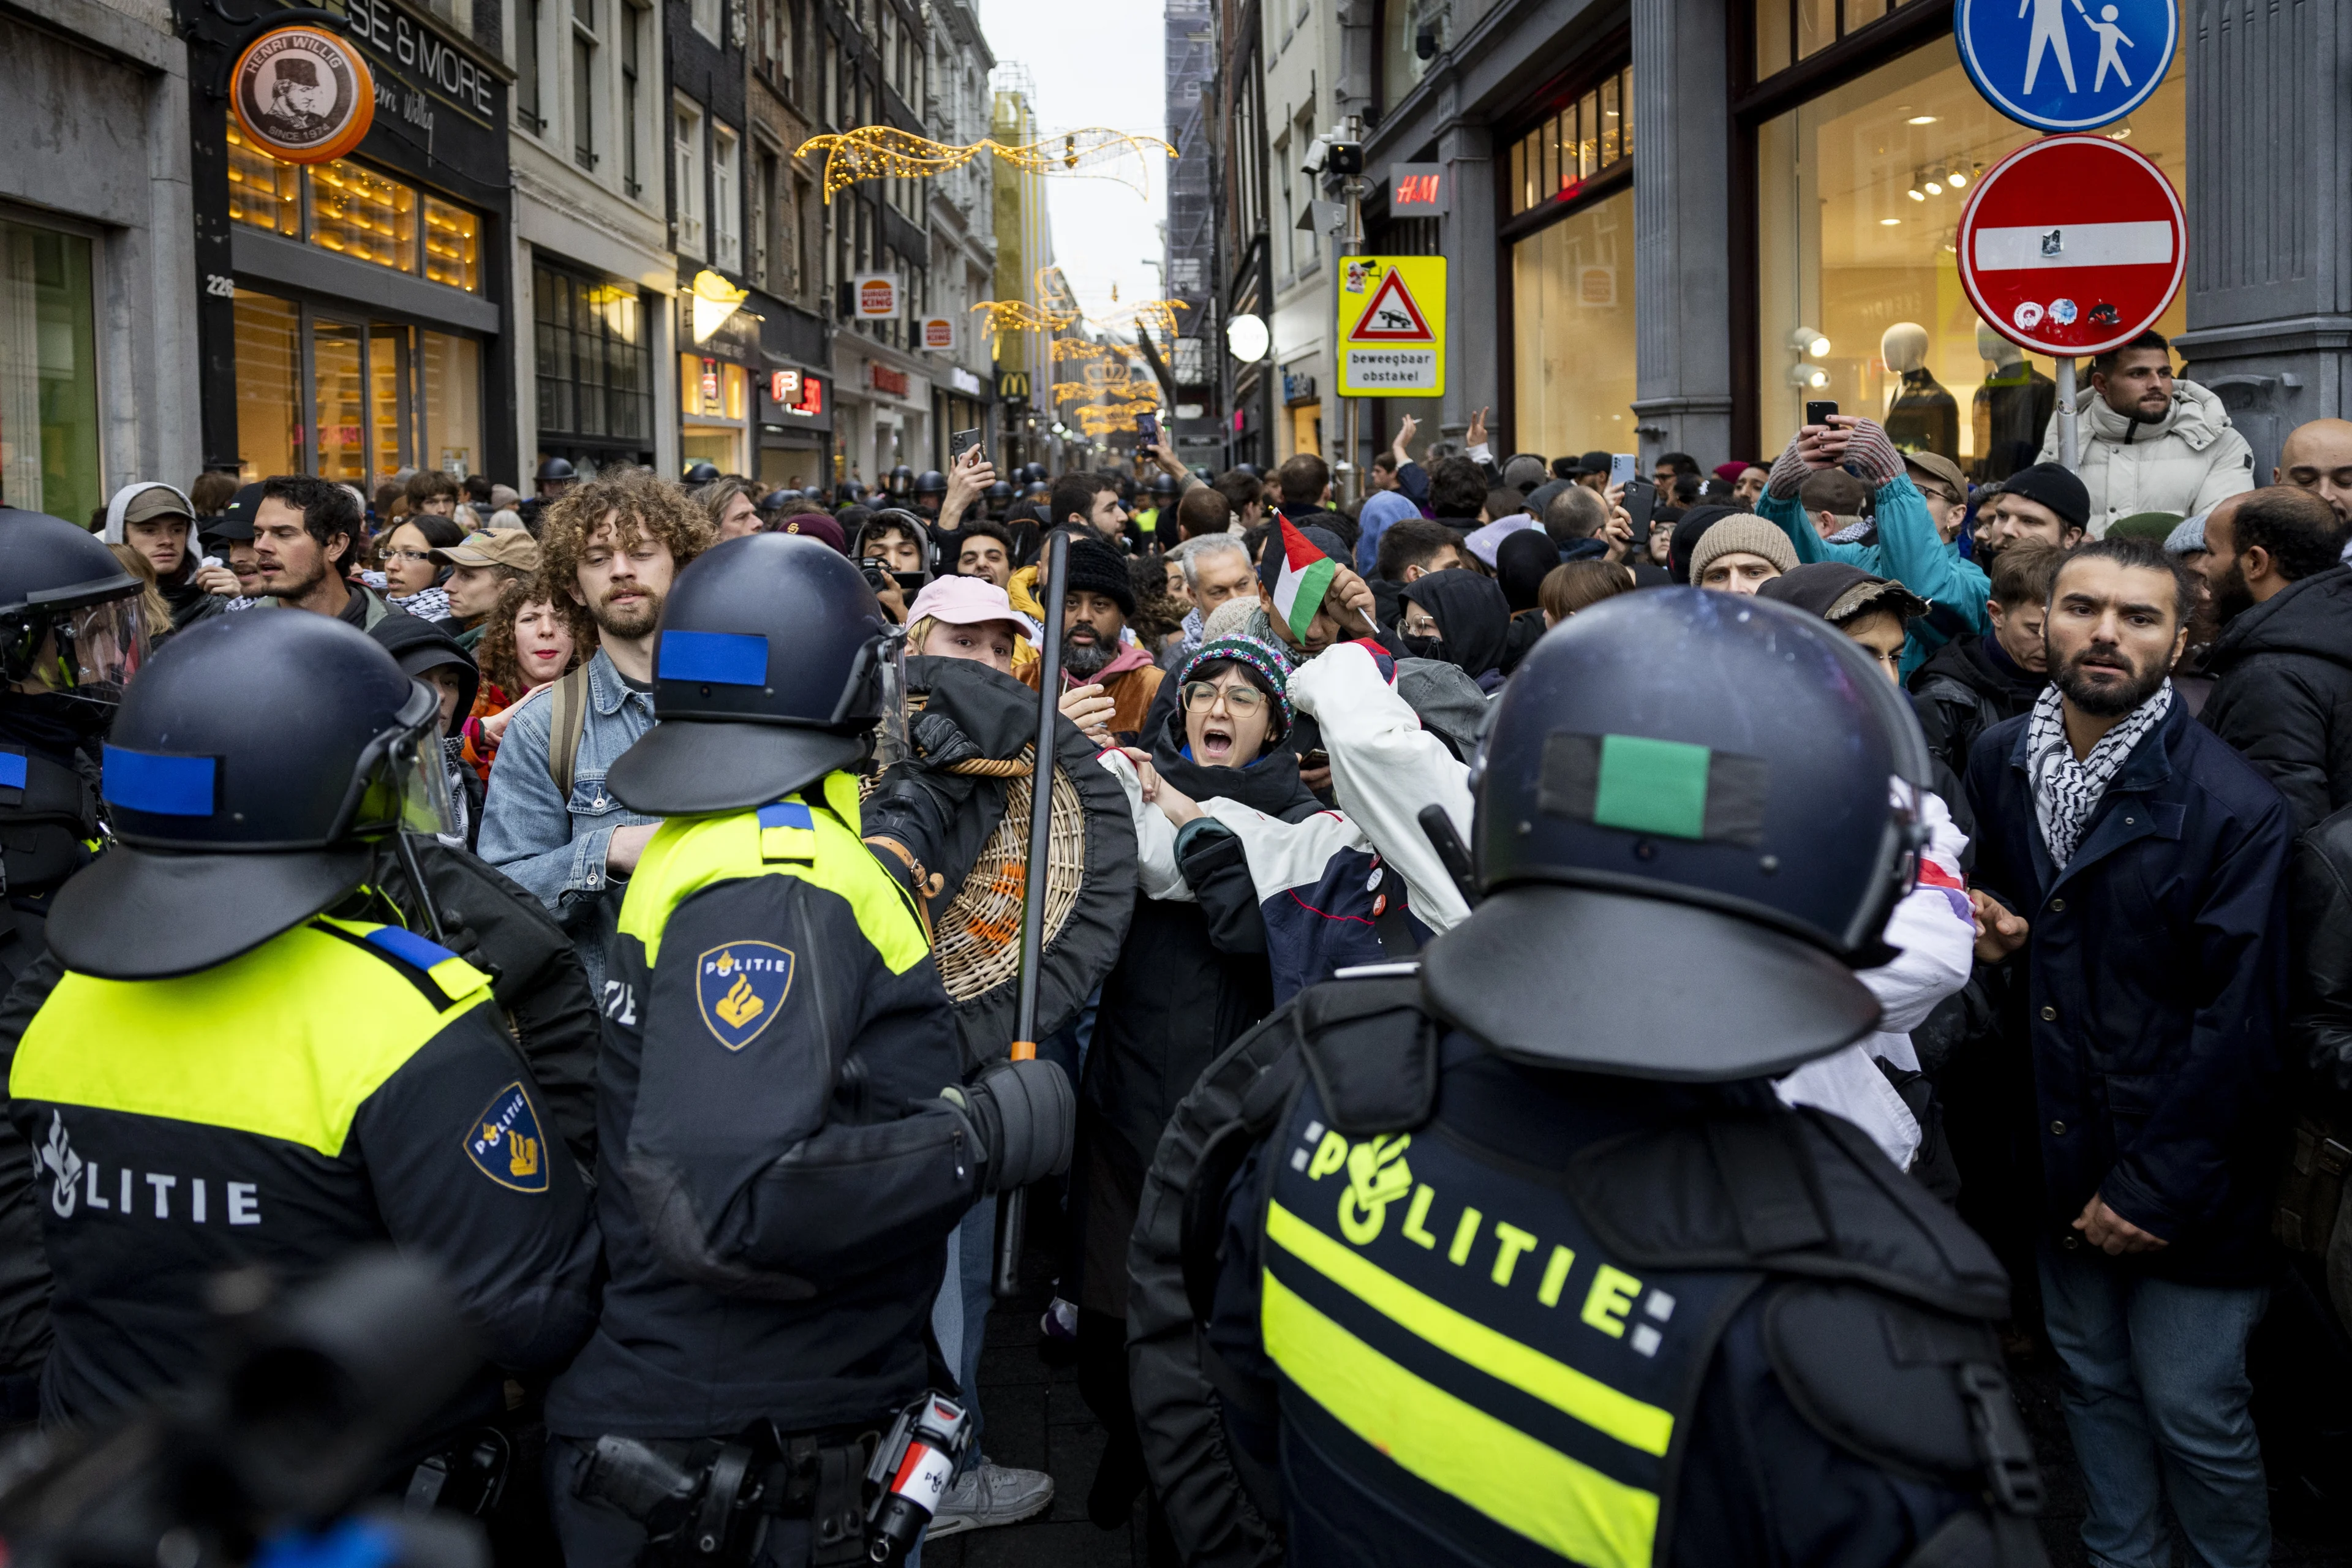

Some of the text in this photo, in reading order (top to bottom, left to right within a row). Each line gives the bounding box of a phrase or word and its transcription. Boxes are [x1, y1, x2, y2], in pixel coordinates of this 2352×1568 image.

[246, 36, 342, 74] HENRI WILLIG
[396, 16, 415, 66] &
[419, 30, 493, 116] MORE
[268, 123, 331, 141] SINCE 1974
[1396, 175, 1439, 204] H&M
[206, 274, 235, 298] 226
[862, 297, 892, 306] KING
[1352, 353, 1431, 366] beweegbaar
[1362, 371, 1419, 382] obstakel
[706, 958, 785, 977] POLITIE
[475, 1094, 524, 1155] POLITIE
[1308, 1130, 1643, 1339] POLITIE
